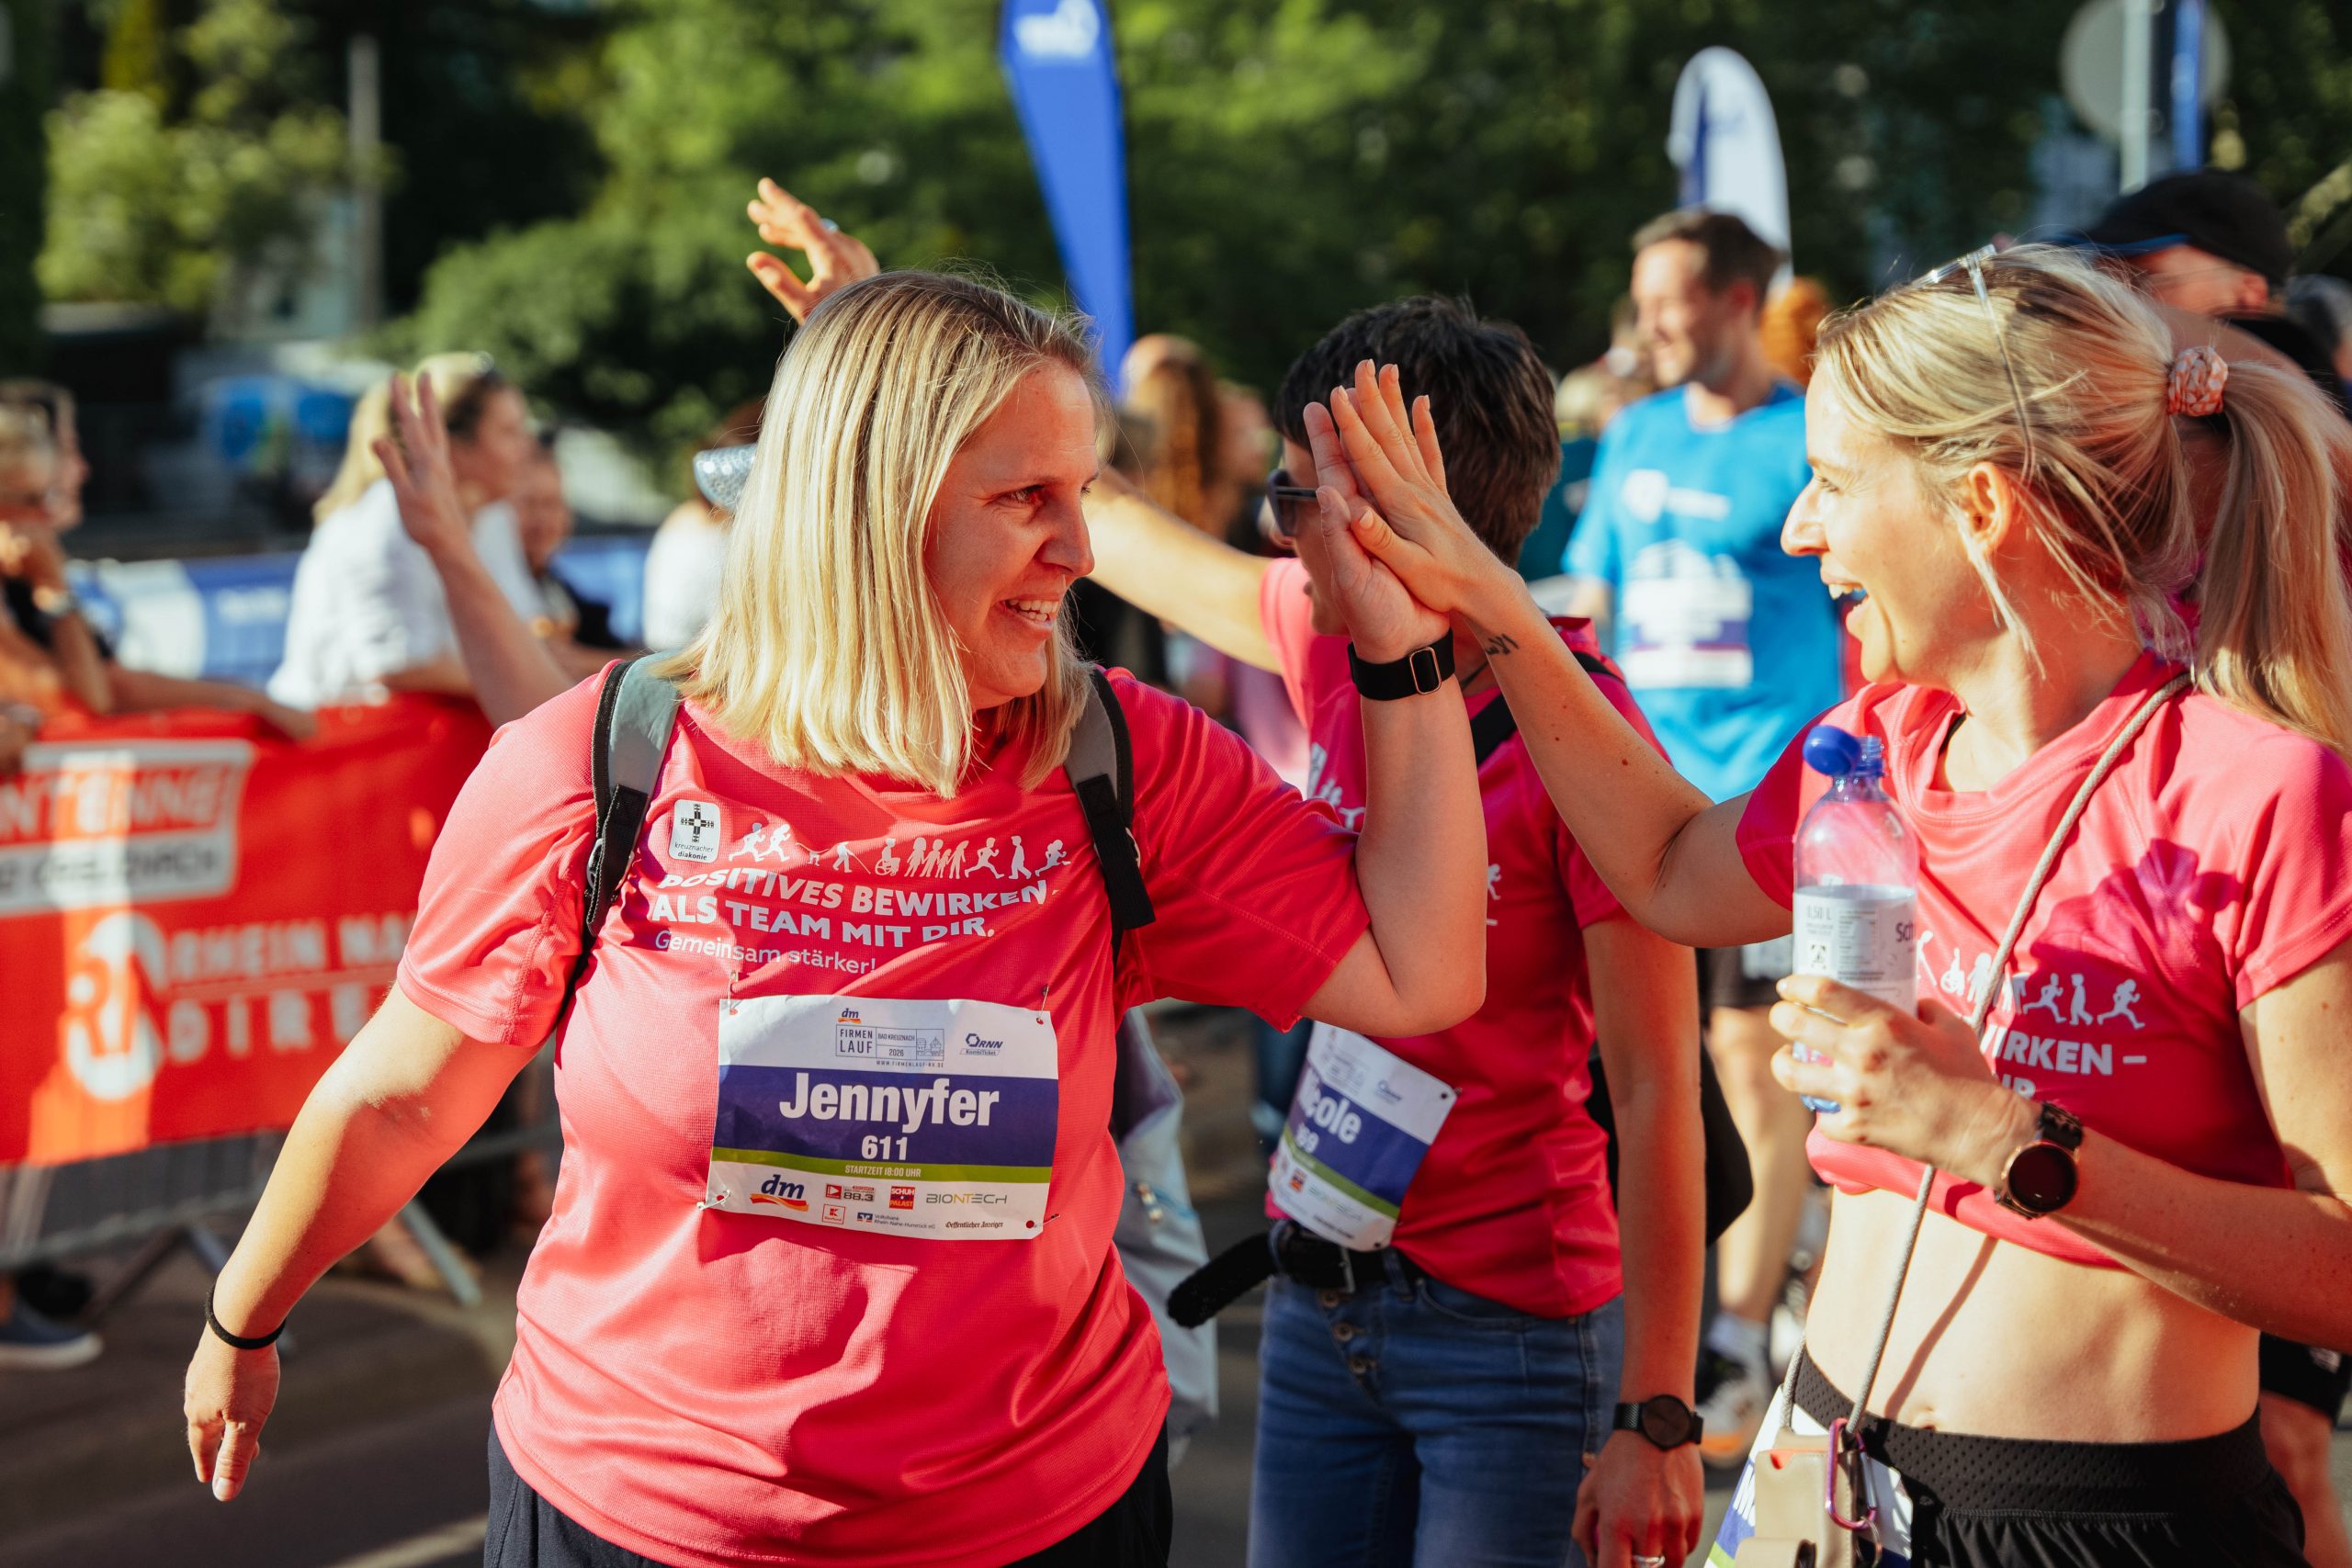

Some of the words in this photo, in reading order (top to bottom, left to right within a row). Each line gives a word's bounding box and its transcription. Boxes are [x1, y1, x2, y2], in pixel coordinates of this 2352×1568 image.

[674, 842, 714, 852] kreuznacher
[678, 852, 707, 861] diakonie
[658, 867, 844, 909] POSITIVES
[651, 894, 718, 924] ALS
[726, 900, 831, 944] TEAM
[842, 922, 912, 948] MIT
[922, 918, 995, 943] DIR.
[655, 930, 781, 963] Gemeinsam
[787, 947, 876, 976] stärker!
[842, 1008, 859, 1019] dm
[840, 1029, 873, 1039] FIRMEN
[840, 1040, 873, 1054] LAUF
[888, 1048, 905, 1057] 2026
[779, 1072, 1000, 1134] Jennyfer
[861, 1135, 908, 1161] 611
[845, 1165, 883, 1176] STARTZEIT
[884, 1166, 904, 1177] 18:00
[905, 1168, 922, 1178] UHR
[761, 1174, 804, 1200] dm
[843, 1191, 874, 1201] 88.3
[926, 1194, 1007, 1204] BIONTECH
